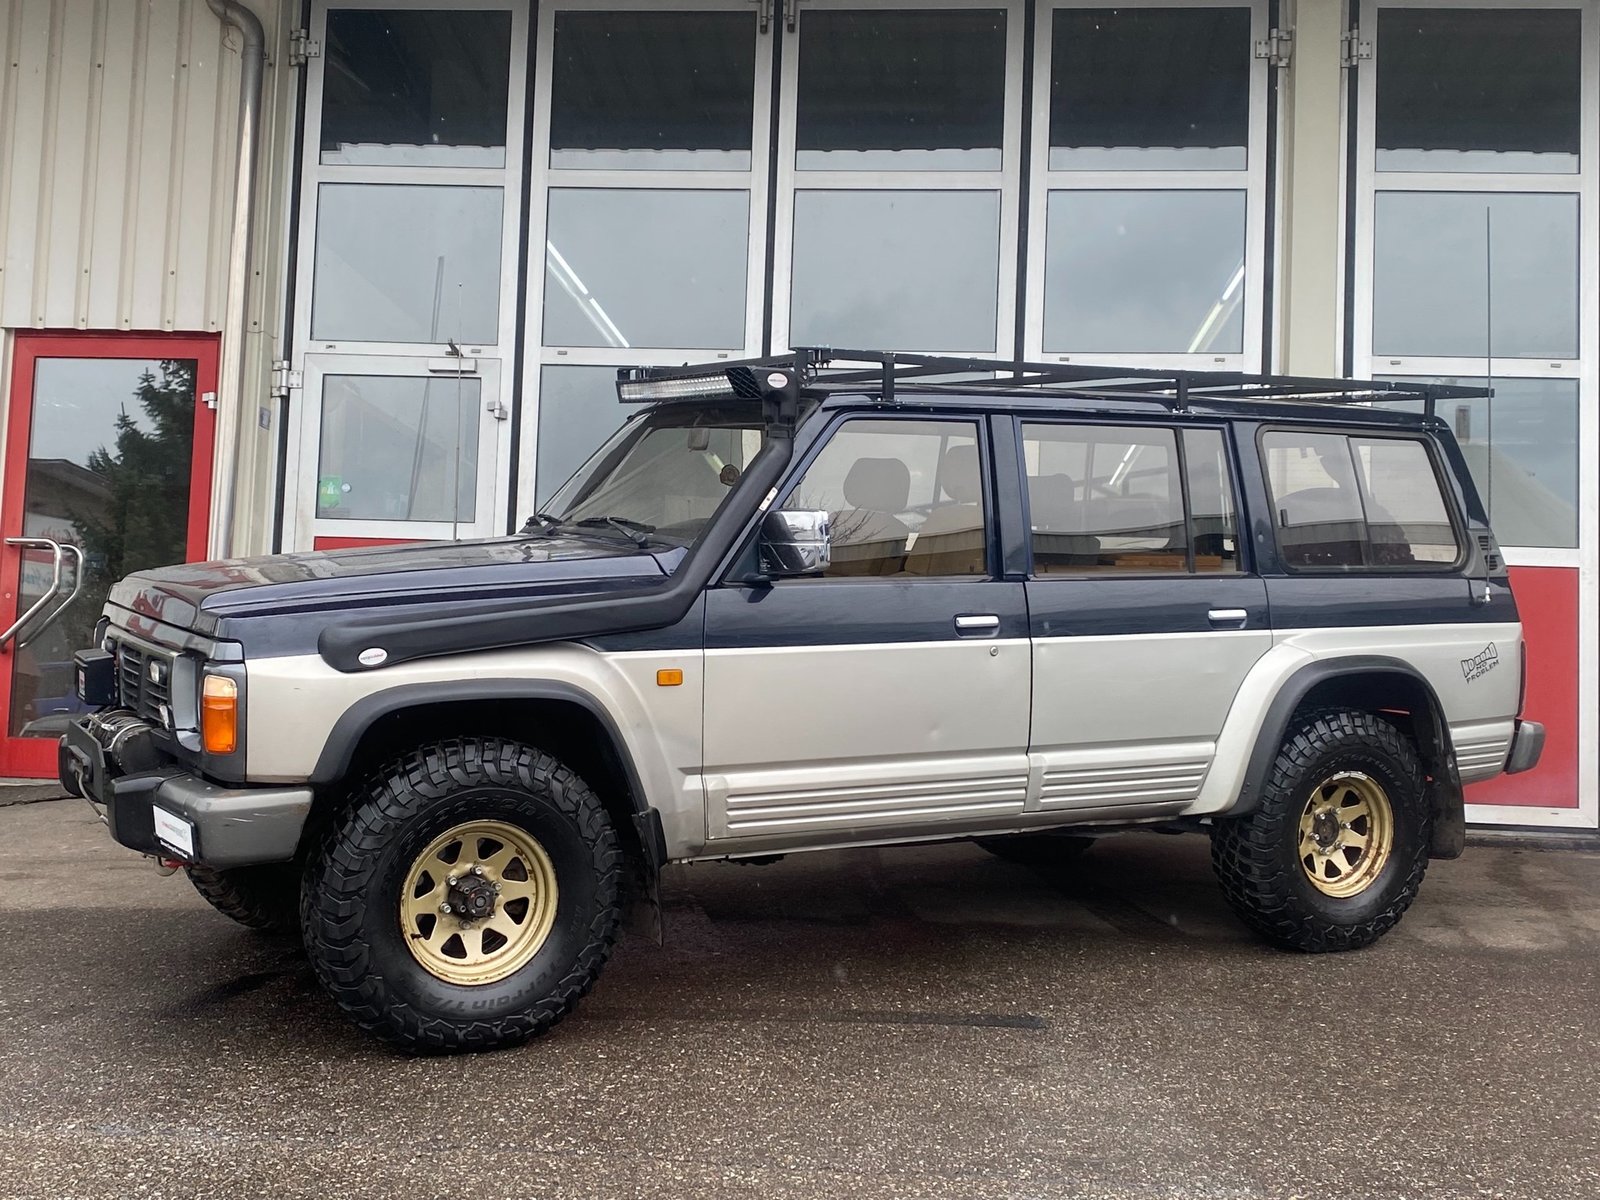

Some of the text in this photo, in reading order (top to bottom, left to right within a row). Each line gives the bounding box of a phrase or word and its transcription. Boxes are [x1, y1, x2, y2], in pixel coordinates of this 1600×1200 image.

[1461, 641, 1498, 678] NO ROAD
[1466, 659, 1499, 684] PROBLEM
[1476, 661, 1487, 671] NO
